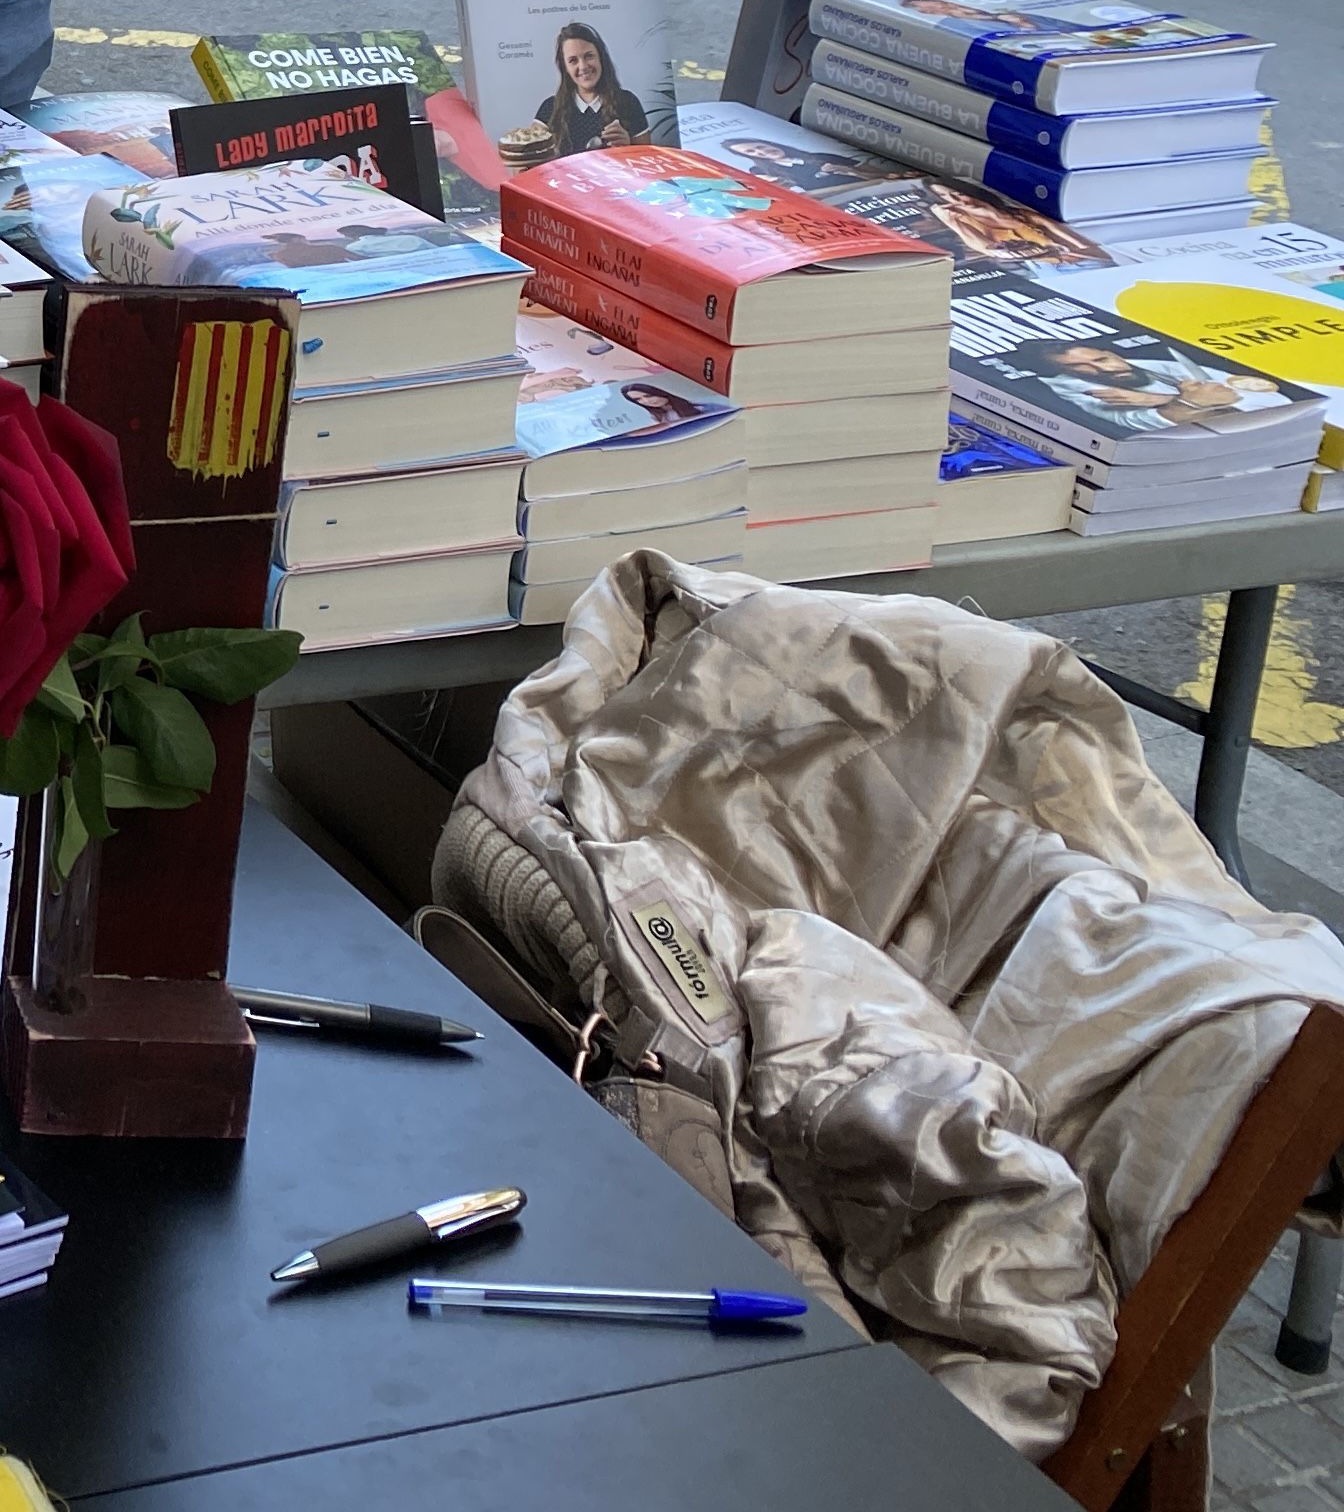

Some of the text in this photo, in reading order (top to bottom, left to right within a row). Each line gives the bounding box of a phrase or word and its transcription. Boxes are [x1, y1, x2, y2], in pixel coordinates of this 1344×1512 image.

[820, 13, 880, 48] COCINA
[867, 20, 903, 38] KARLOS
[248, 45, 415, 69] COME BIEN,
[885, 35, 945, 72] BUENA
[265, 66, 419, 89] NO HAGAS
[823, 61, 889, 98] COCINA
[877, 69, 910, 89] KARLOS
[892, 79, 954, 121] BUENA
[814, 107, 880, 147] COCINA
[867, 116, 903, 136] KARLOS
[883, 133, 946, 171] BUENA
[175, 186, 363, 225] LARK
[190, 181, 299, 204] SARAH
[233, 217, 297, 234] donde
[297, 211, 342, 228] nace
[346, 206, 368, 218] el
[368, 200, 400, 216] día
[118, 231, 150, 261] SARAH
[1260, 232, 1329, 254] 15
[109, 241, 153, 286] LARK
[1198, 318, 1344, 351] SIMPLE
